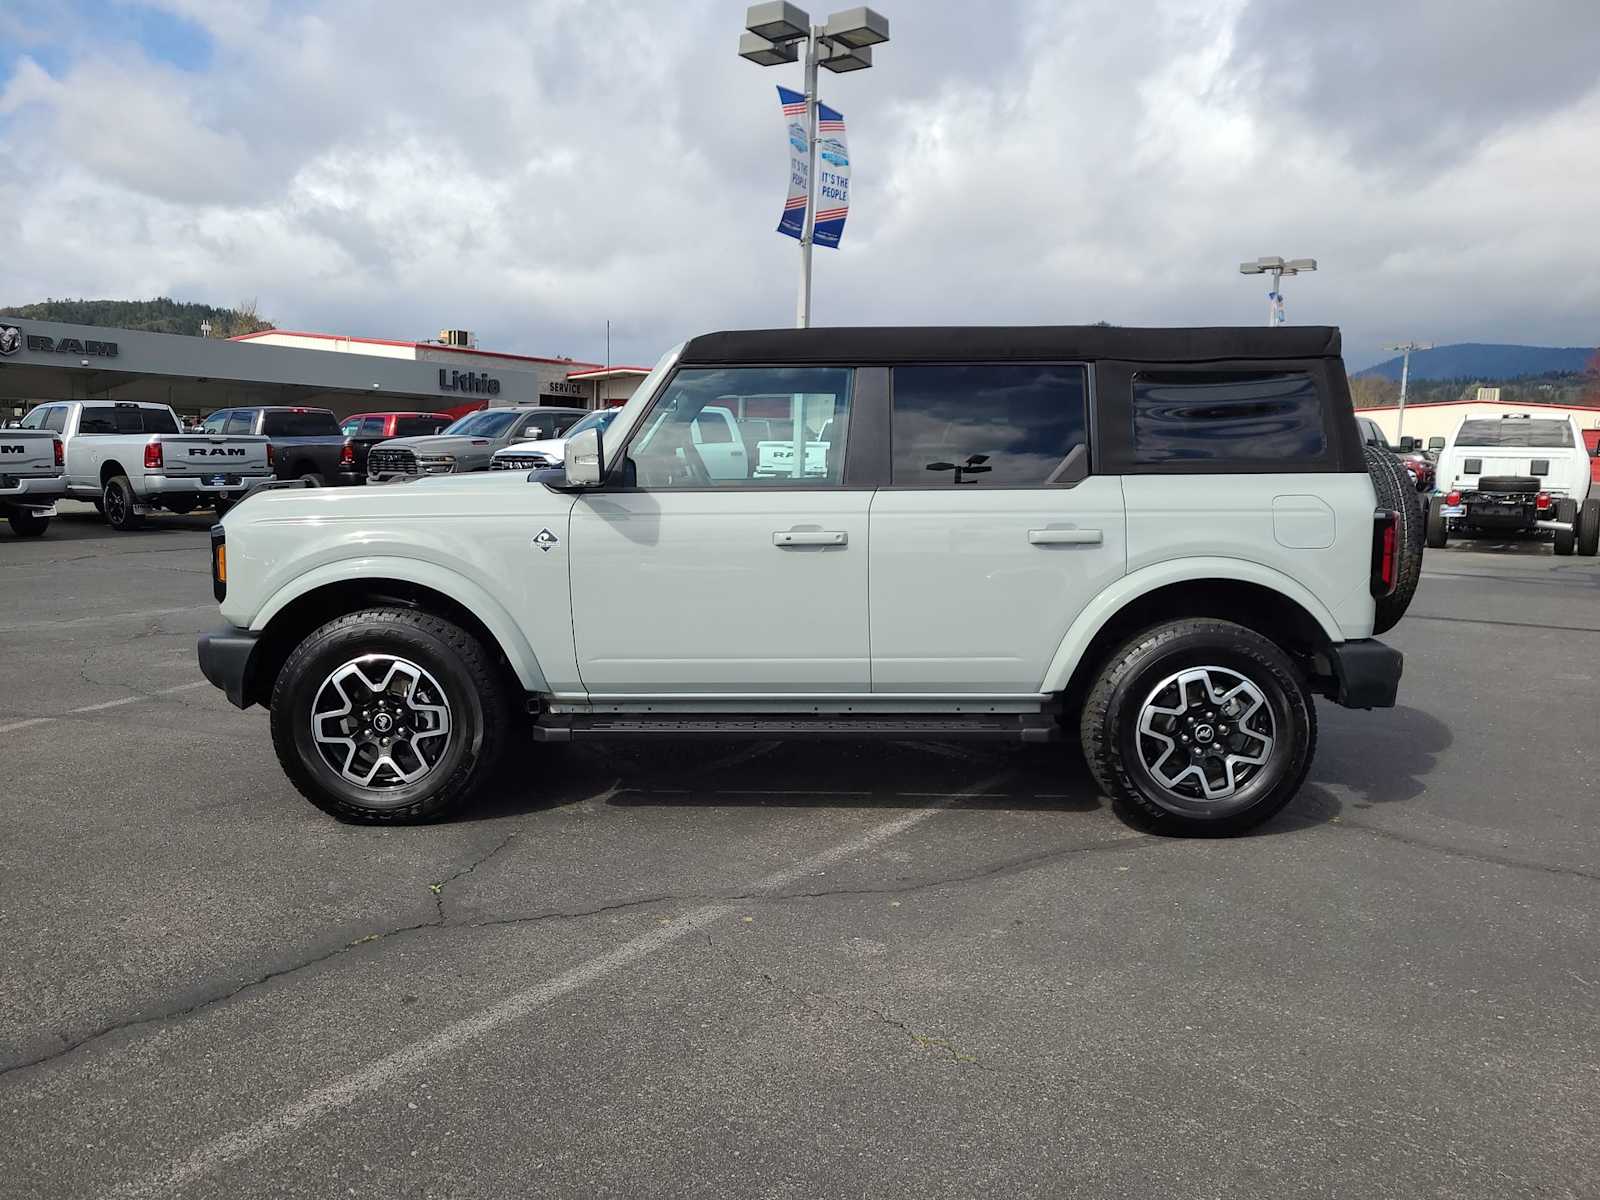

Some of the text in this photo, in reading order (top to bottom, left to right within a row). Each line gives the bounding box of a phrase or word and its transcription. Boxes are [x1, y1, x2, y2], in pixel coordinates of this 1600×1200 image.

[822, 172, 848, 189] IT'S THE
[822, 186, 847, 201] PEOPLE
[27, 334, 120, 357] RAM
[439, 369, 500, 394] Lithia
[550, 382, 581, 394] SERVICE
[188, 448, 246, 456] RAM
